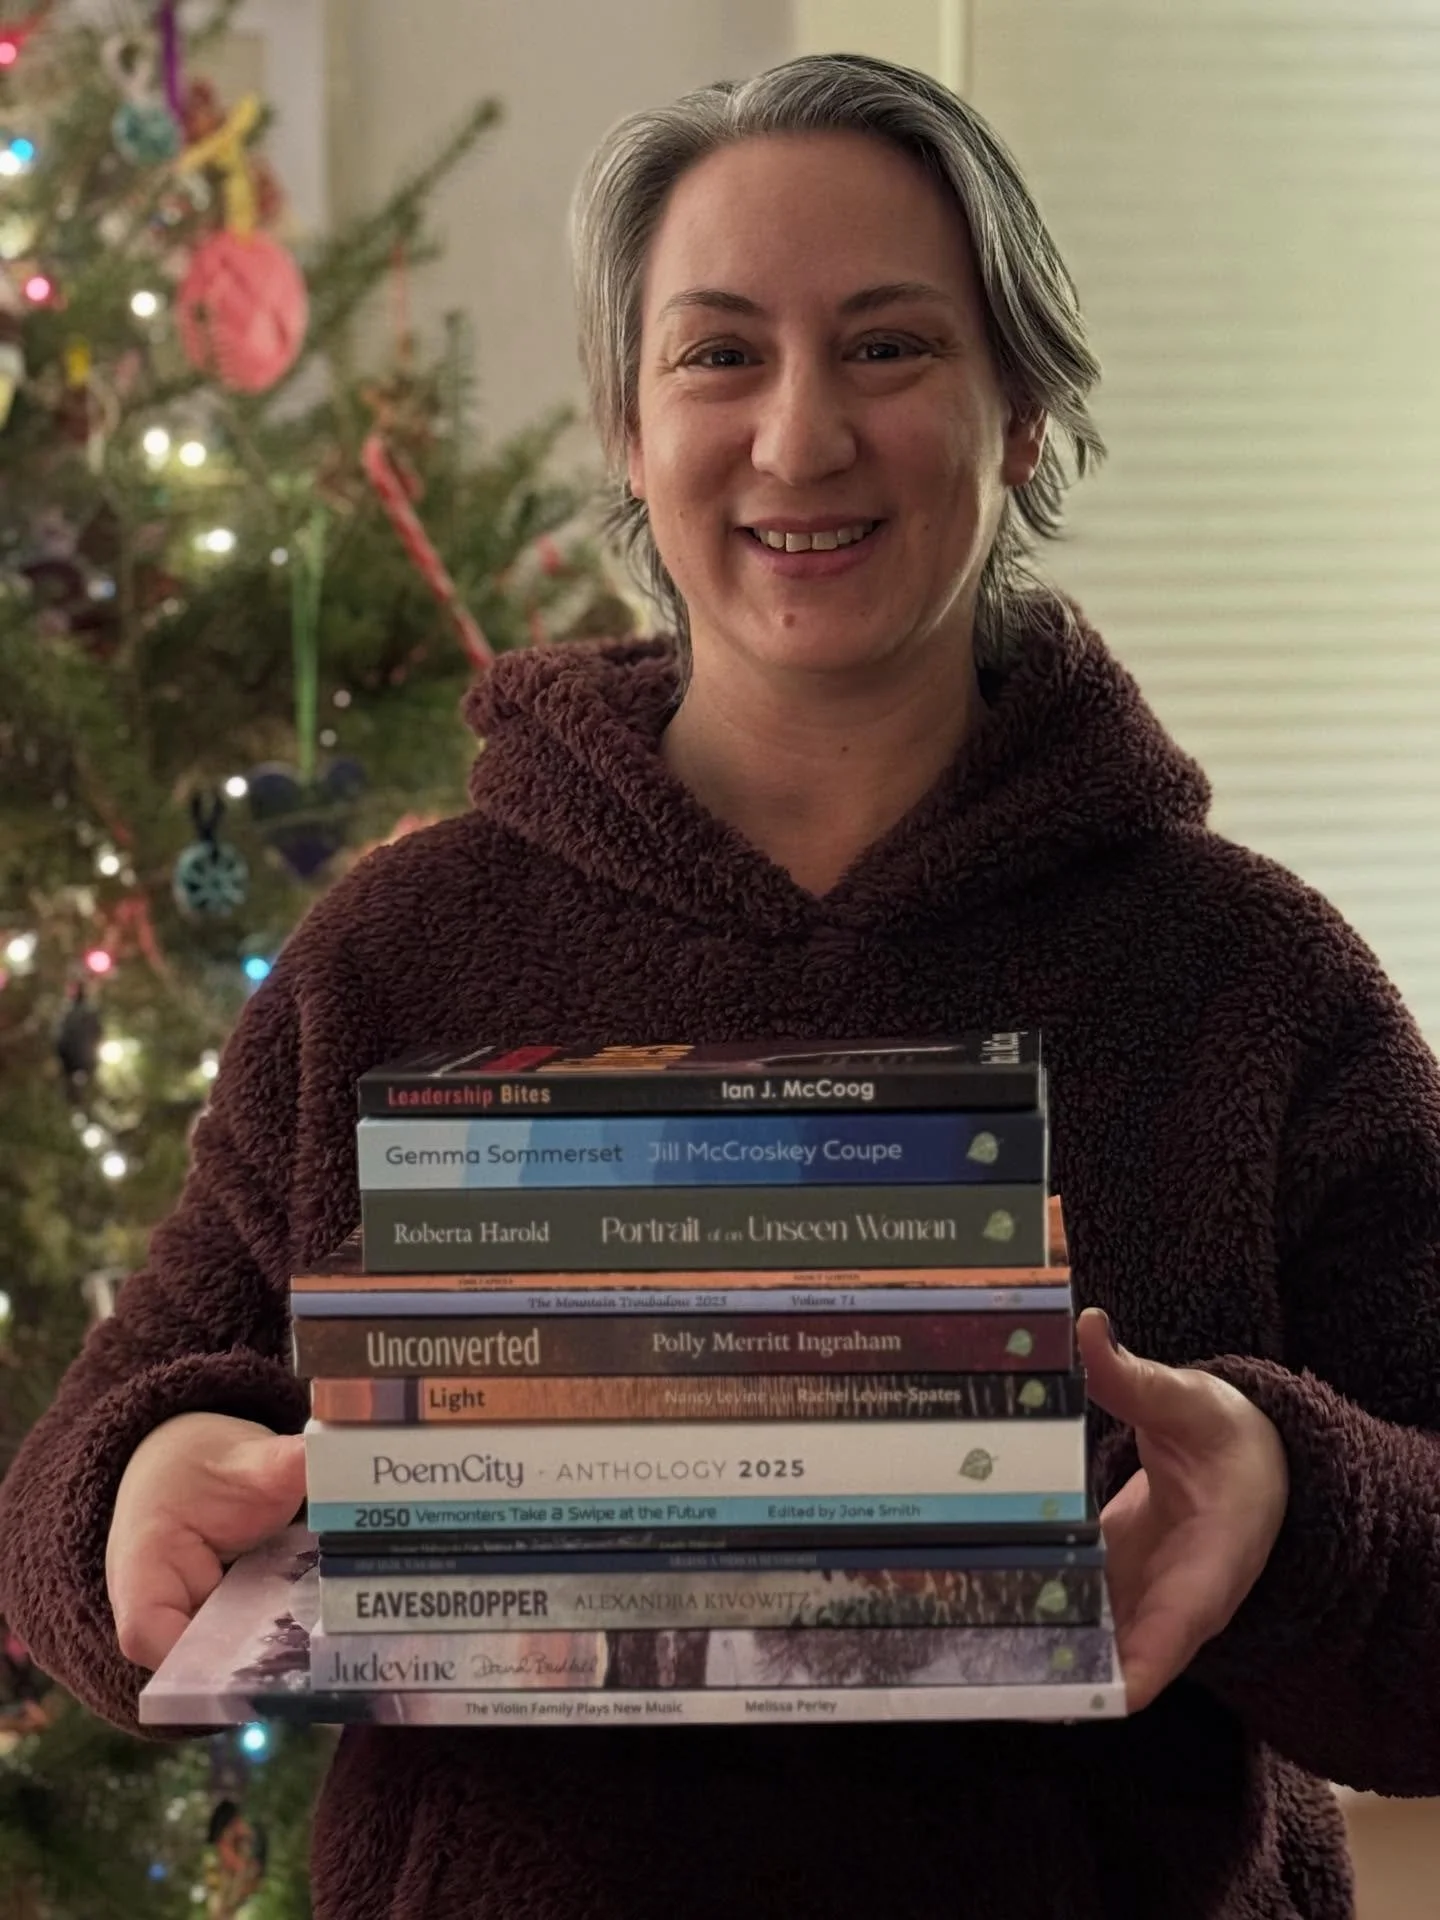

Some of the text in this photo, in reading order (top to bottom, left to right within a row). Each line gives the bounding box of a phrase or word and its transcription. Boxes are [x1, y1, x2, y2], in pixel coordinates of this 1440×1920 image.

[388, 1084, 551, 1108] Leadership Bites
[722, 1079, 875, 1101] Ian J. McCoog
[385, 1143, 624, 1166] Gemma Sommerset
[647, 1139, 903, 1165] Jill McCroskey Coupe
[393, 1219, 550, 1244] Roberta Harold
[601, 1215, 700, 1244] Portrait
[748, 1215, 848, 1242] Unseen
[855, 1214, 957, 1241] Woman
[528, 1297, 551, 1309] The
[555, 1296, 616, 1309] Mountain
[791, 1294, 837, 1307] Volume
[366, 1327, 541, 1368] Unconverted
[652, 1330, 902, 1358] Polly Merritt Ingraham
[429, 1388, 486, 1413] Light
[665, 1390, 713, 1406] Nancy
[797, 1387, 961, 1405] Rachel Levine-Spates
[372, 1454, 806, 1489] PoemCity ANTHOLOGY 2025
[354, 1504, 718, 1528] 2050 Vermonters Take a Swipe at the Future
[767, 1503, 921, 1521] Edited by Jane Smith
[355, 1589, 549, 1619] EAVESDROPPER
[574, 1591, 811, 1611] ALEXANDRA KIVOWITZ
[328, 1651, 457, 1682] Judevine
[465, 1701, 684, 1718] The Violin Family Plays New Music
[745, 1699, 838, 1715] Melissa Perley
